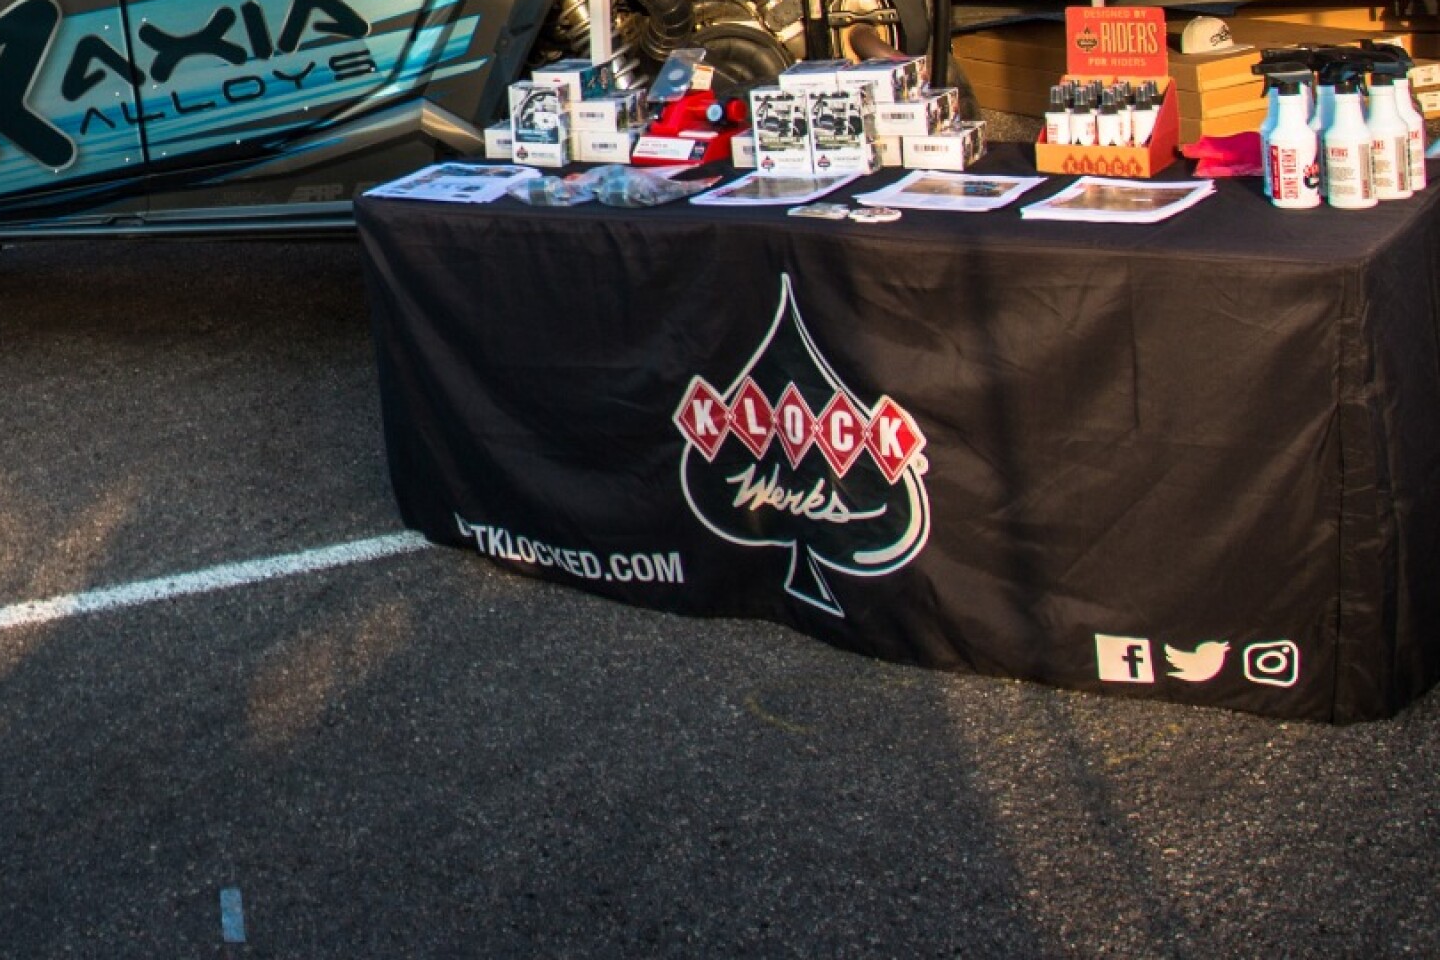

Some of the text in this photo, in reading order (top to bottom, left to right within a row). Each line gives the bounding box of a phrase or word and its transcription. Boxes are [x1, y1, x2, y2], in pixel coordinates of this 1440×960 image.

[1133, 10, 1147, 19] BY
[1101, 22, 1158, 54] RIDERS
[1088, 57, 1146, 66] FOR RIDERS
[79, 49, 376, 136] ALLOYS
[682, 386, 916, 472] KLOCK
[726, 464, 888, 523] Werks
